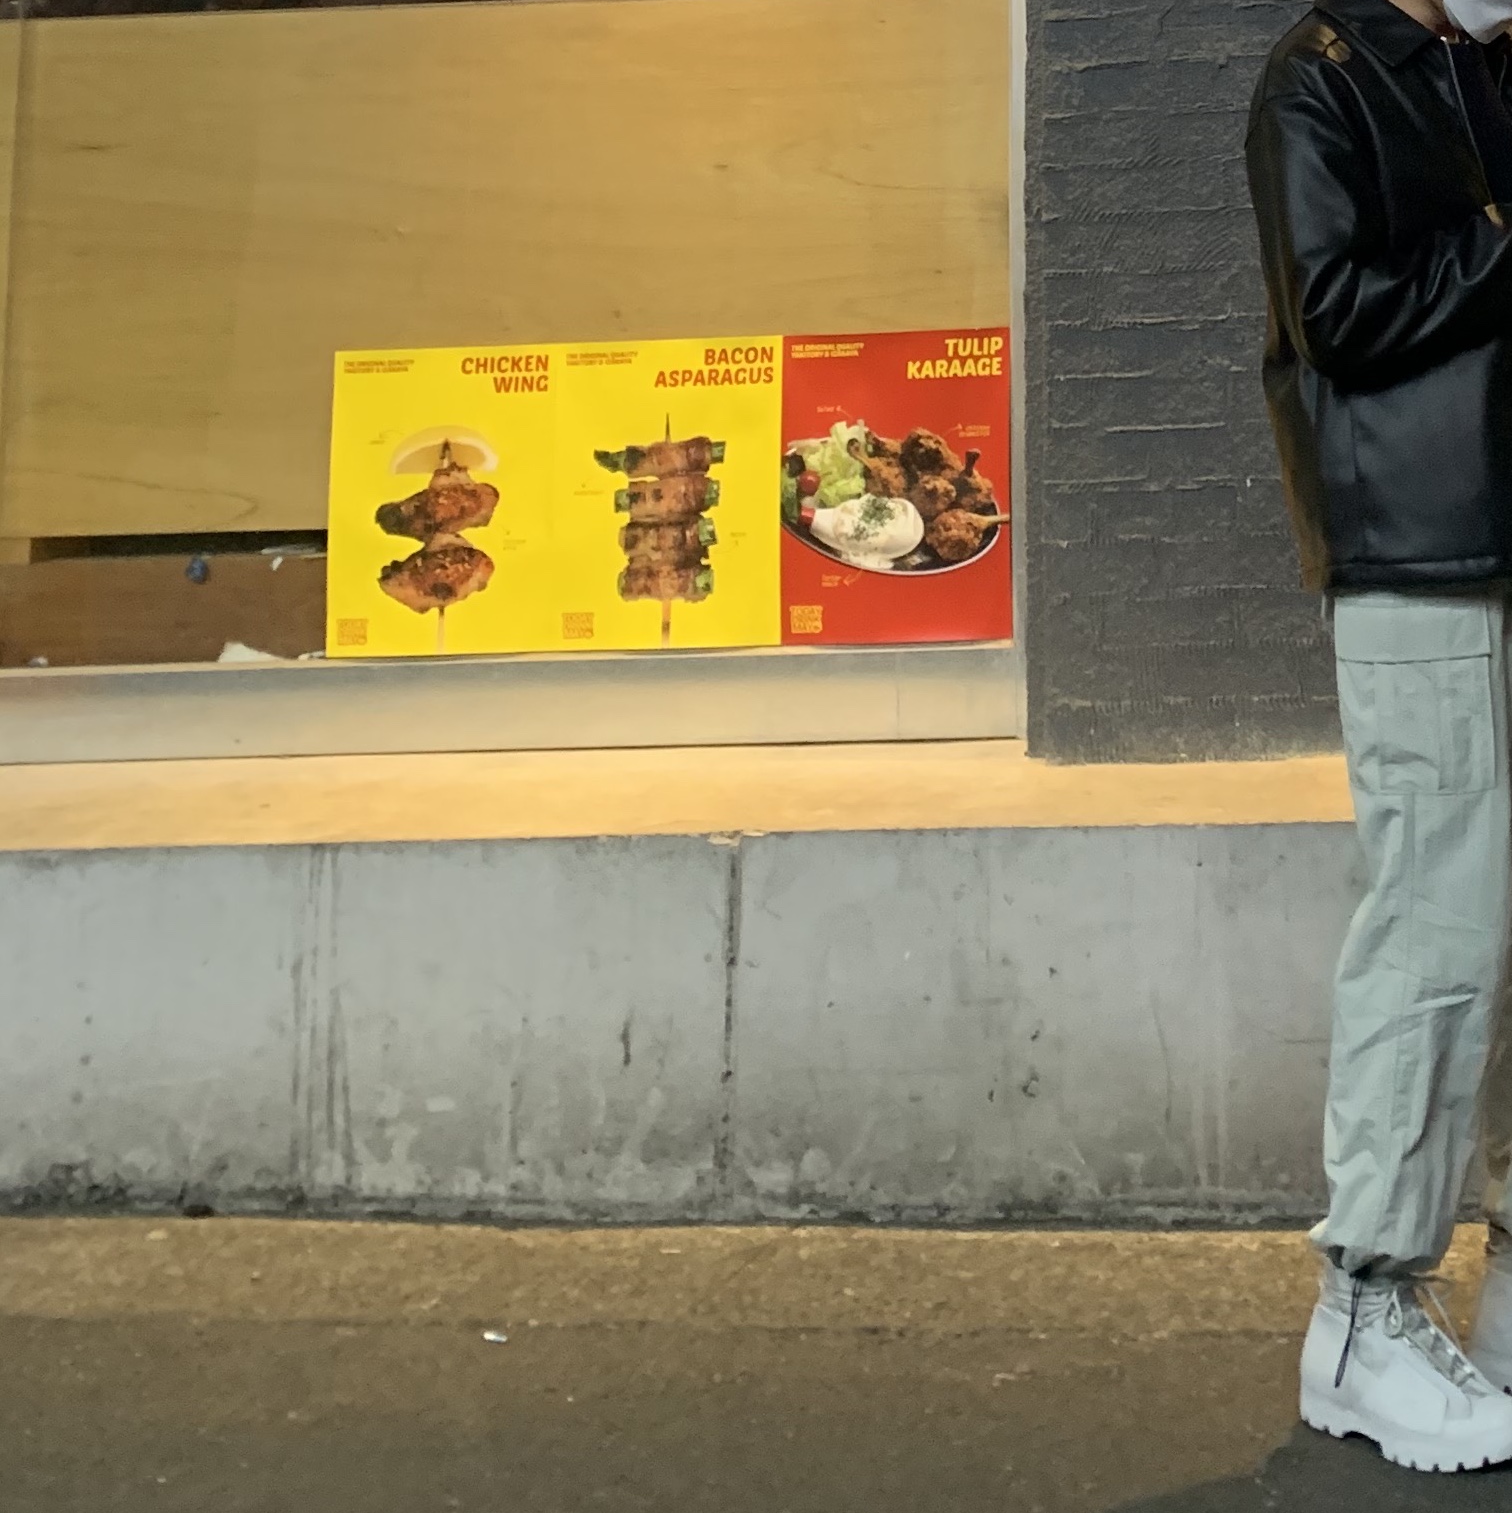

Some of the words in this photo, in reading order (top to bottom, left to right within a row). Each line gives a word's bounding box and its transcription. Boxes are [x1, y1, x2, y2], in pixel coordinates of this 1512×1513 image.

[704, 346, 774, 365] BACON
[945, 336, 1003, 357] TULIP
[461, 354, 549, 375] CHICKEN
[907, 357, 1002, 379] KARAAGE
[493, 375, 549, 393] WING
[654, 366, 774, 388] ASPARAGUS
